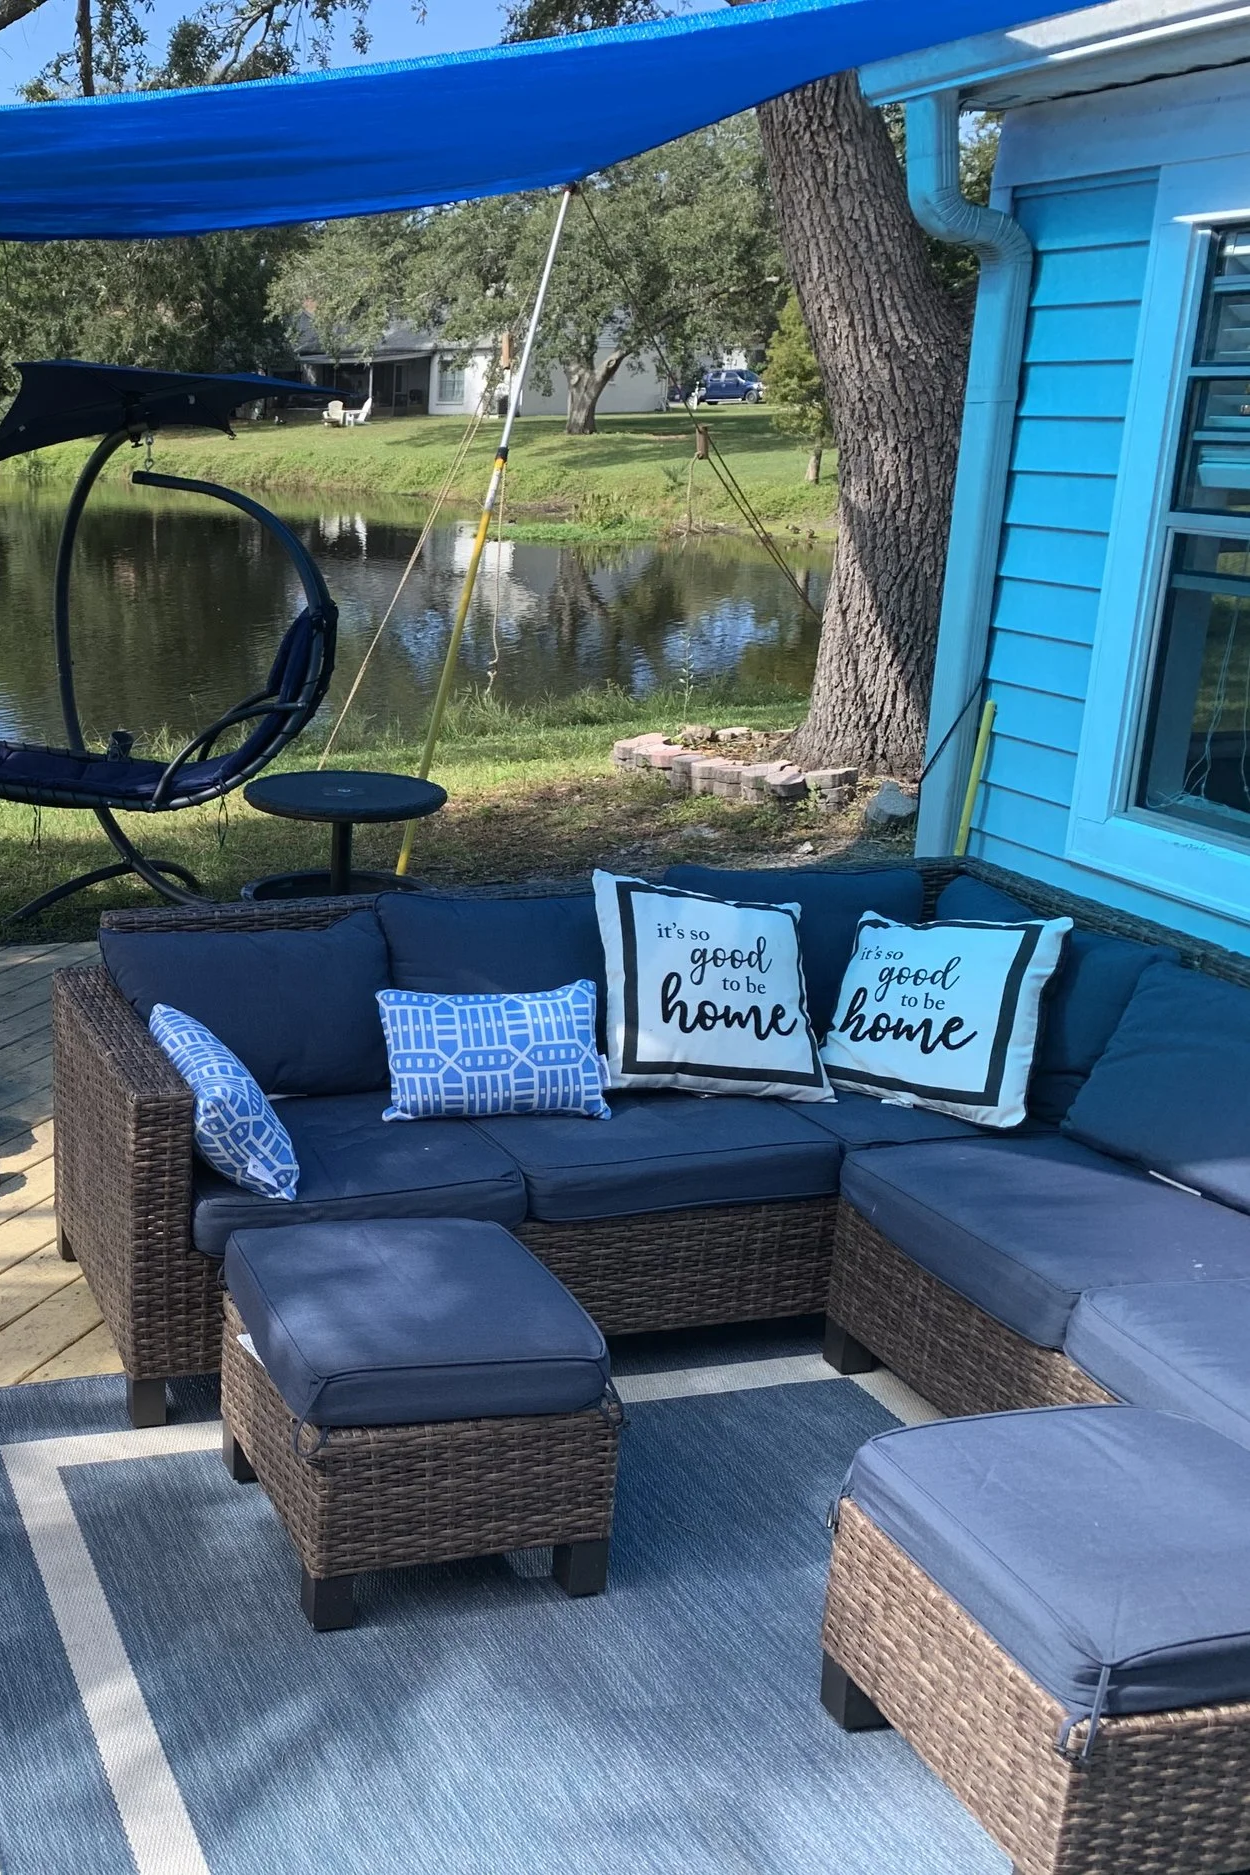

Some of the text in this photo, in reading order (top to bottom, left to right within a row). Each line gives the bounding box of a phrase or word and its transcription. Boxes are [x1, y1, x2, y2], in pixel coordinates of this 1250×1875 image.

[657, 922, 710, 941] it's so
[690, 936, 773, 986] good
[860, 945, 904, 961] it's so
[722, 975, 767, 995] to be
[874, 956, 962, 1003] good
[661, 971, 798, 1041] home
[901, 992, 946, 1011] to be
[838, 986, 978, 1055] home
